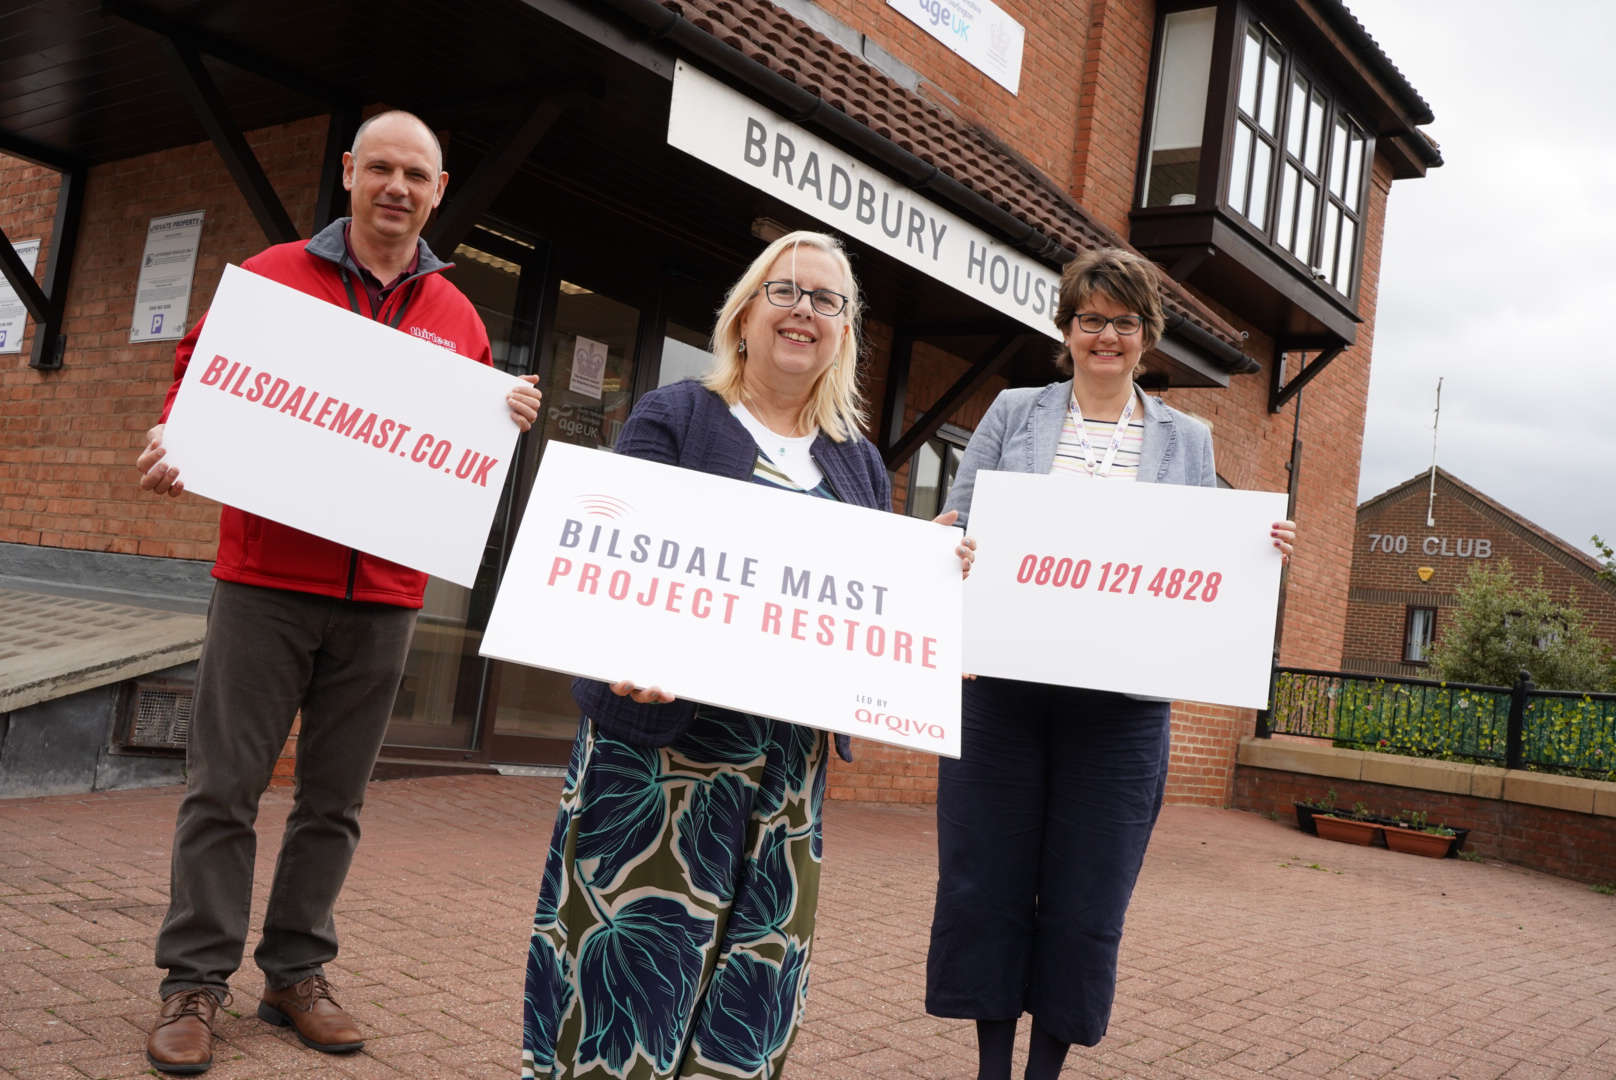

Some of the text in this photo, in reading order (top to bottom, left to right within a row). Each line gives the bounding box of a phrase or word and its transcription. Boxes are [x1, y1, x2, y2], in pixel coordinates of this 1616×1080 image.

[743, 117, 948, 261] BRADBURY
[199, 354, 498, 488] BILSDALEMAST.CO.UK
[559, 518, 889, 616] BILSDALE MAST
[1016, 553, 1223, 603] 0800 121 4828
[1368, 533, 1493, 558] 700 CLUB
[547, 556, 938, 670] PROJECT RESTORE
